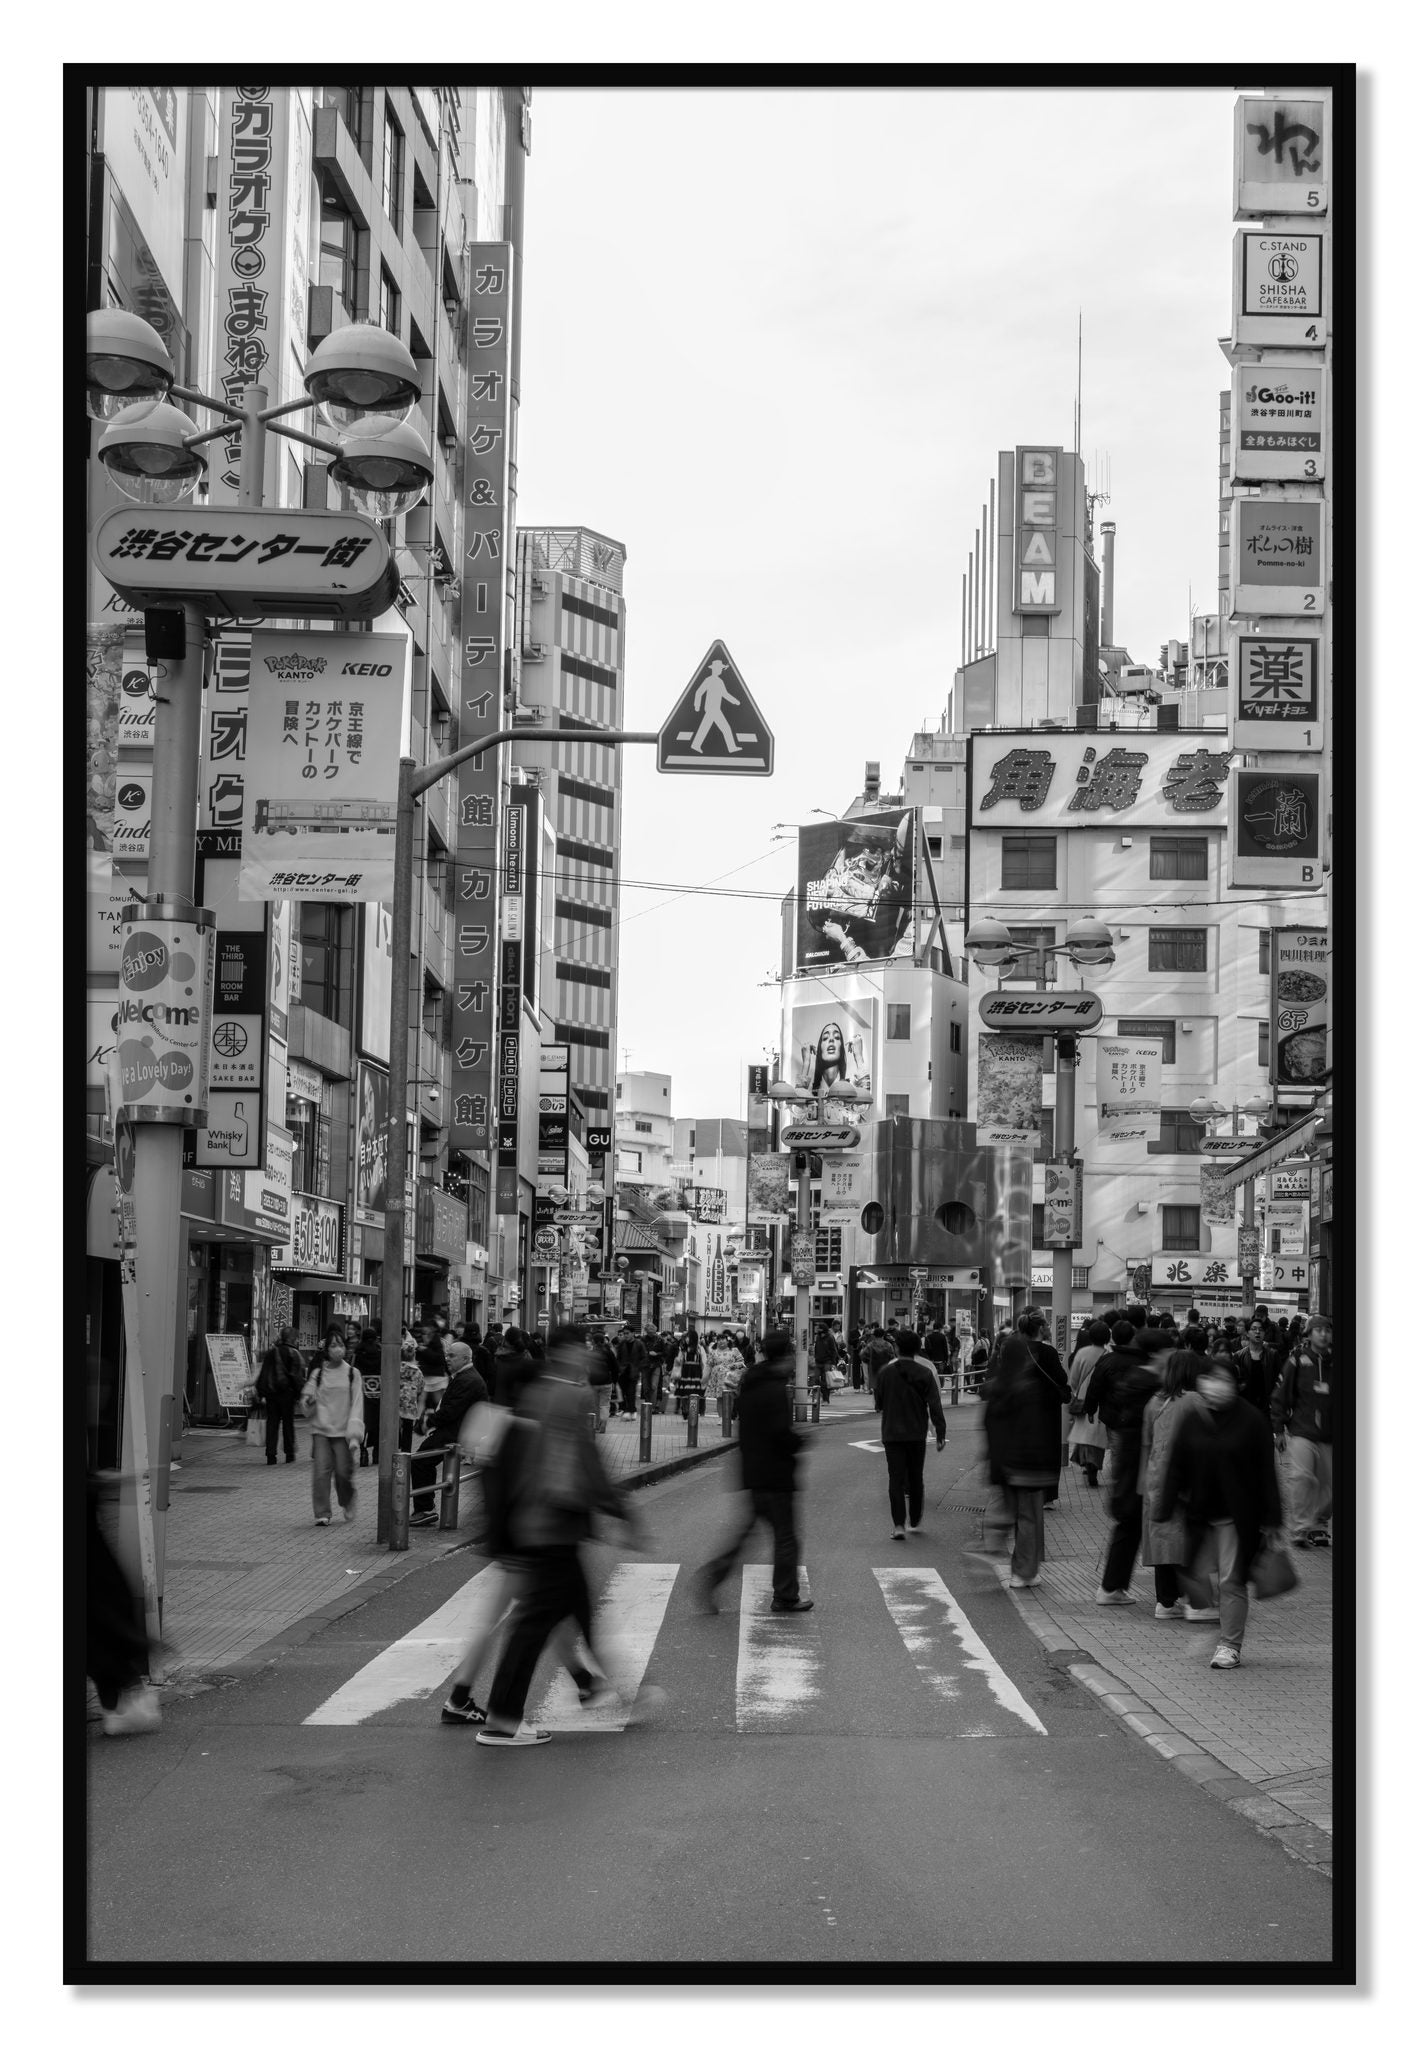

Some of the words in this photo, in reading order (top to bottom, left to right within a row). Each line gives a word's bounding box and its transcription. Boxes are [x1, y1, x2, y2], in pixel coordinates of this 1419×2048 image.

[229, 102, 273, 247] カラオケ
[1306, 191, 1319, 207] 5
[1260, 242, 1307, 251] C.STAND
[1260, 285, 1307, 295] SHISHA
[1305, 325, 1318, 341] 4
[1258, 387, 1316, 405] Goo-it!
[1251, 409, 1312, 418] 渋谷宇田川町店
[1245, 435, 1317, 448] 全身もみほぐし
[1304, 459, 1317, 477] 3
[1021, 451, 1057, 604] BEAM
[109, 529, 373, 567] 渋谷センター街
[1303, 594, 1316, 610] 2
[277, 671, 315, 679] KANTO
[341, 663, 392, 677] KEIO
[1250, 645, 1303, 698] 薬
[1244, 703, 1309, 716] マツモトキヨシ
[282, 701, 299, 745] 冒険へ
[123, 730, 149, 739] 渋谷店
[302, 701, 320, 779] カントーの
[324, 701, 342, 779] ポケパーク
[347, 702, 364, 764] 京王線で
[1303, 730, 1311, 746] 1
[980, 747, 1234, 811] 角海老
[1244, 789, 1308, 839] 一蘭
[509, 810, 519, 848] kimono
[119, 843, 145, 852] 渋谷店
[269, 872, 363, 887] 渋谷センター街
[508, 854, 518, 889] hearts
[1302, 865, 1314, 882] B
[806, 878, 848, 892] SHAPING
[1280, 949, 1327, 962] 四川料理
[122, 947, 165, 983] Enjoy
[221, 982, 243, 990] ROOM
[455, 869, 491, 1127] カラオケ館
[119, 998, 199, 1026] Welcome
[987, 1001, 1095, 1014] 渋谷センター街
[1278, 1010, 1308, 1031] 6F
[149, 1022, 169, 1042] Shibuya
[130, 1068, 135, 1083] a
[137, 1060, 168, 1080] Lovely
[170, 1061, 192, 1077] Day!
[1120, 1063, 1128, 1093] カントーの
[1129, 1064, 1137, 1093] ポケパーク
[552, 1103, 565, 1111] UP
[208, 1130, 243, 1142] Whisky
[589, 1134, 609, 1145] GU
[784, 1130, 850, 1140] 渋谷センター街
[1110, 1130, 1147, 1139] 渋谷センター街
[208, 1140, 228, 1149] Bank
[1203, 1141, 1263, 1150] 渋谷センター街
[1166, 1260, 1229, 1283] 兆楽
[714, 1258, 723, 1303] BEER
